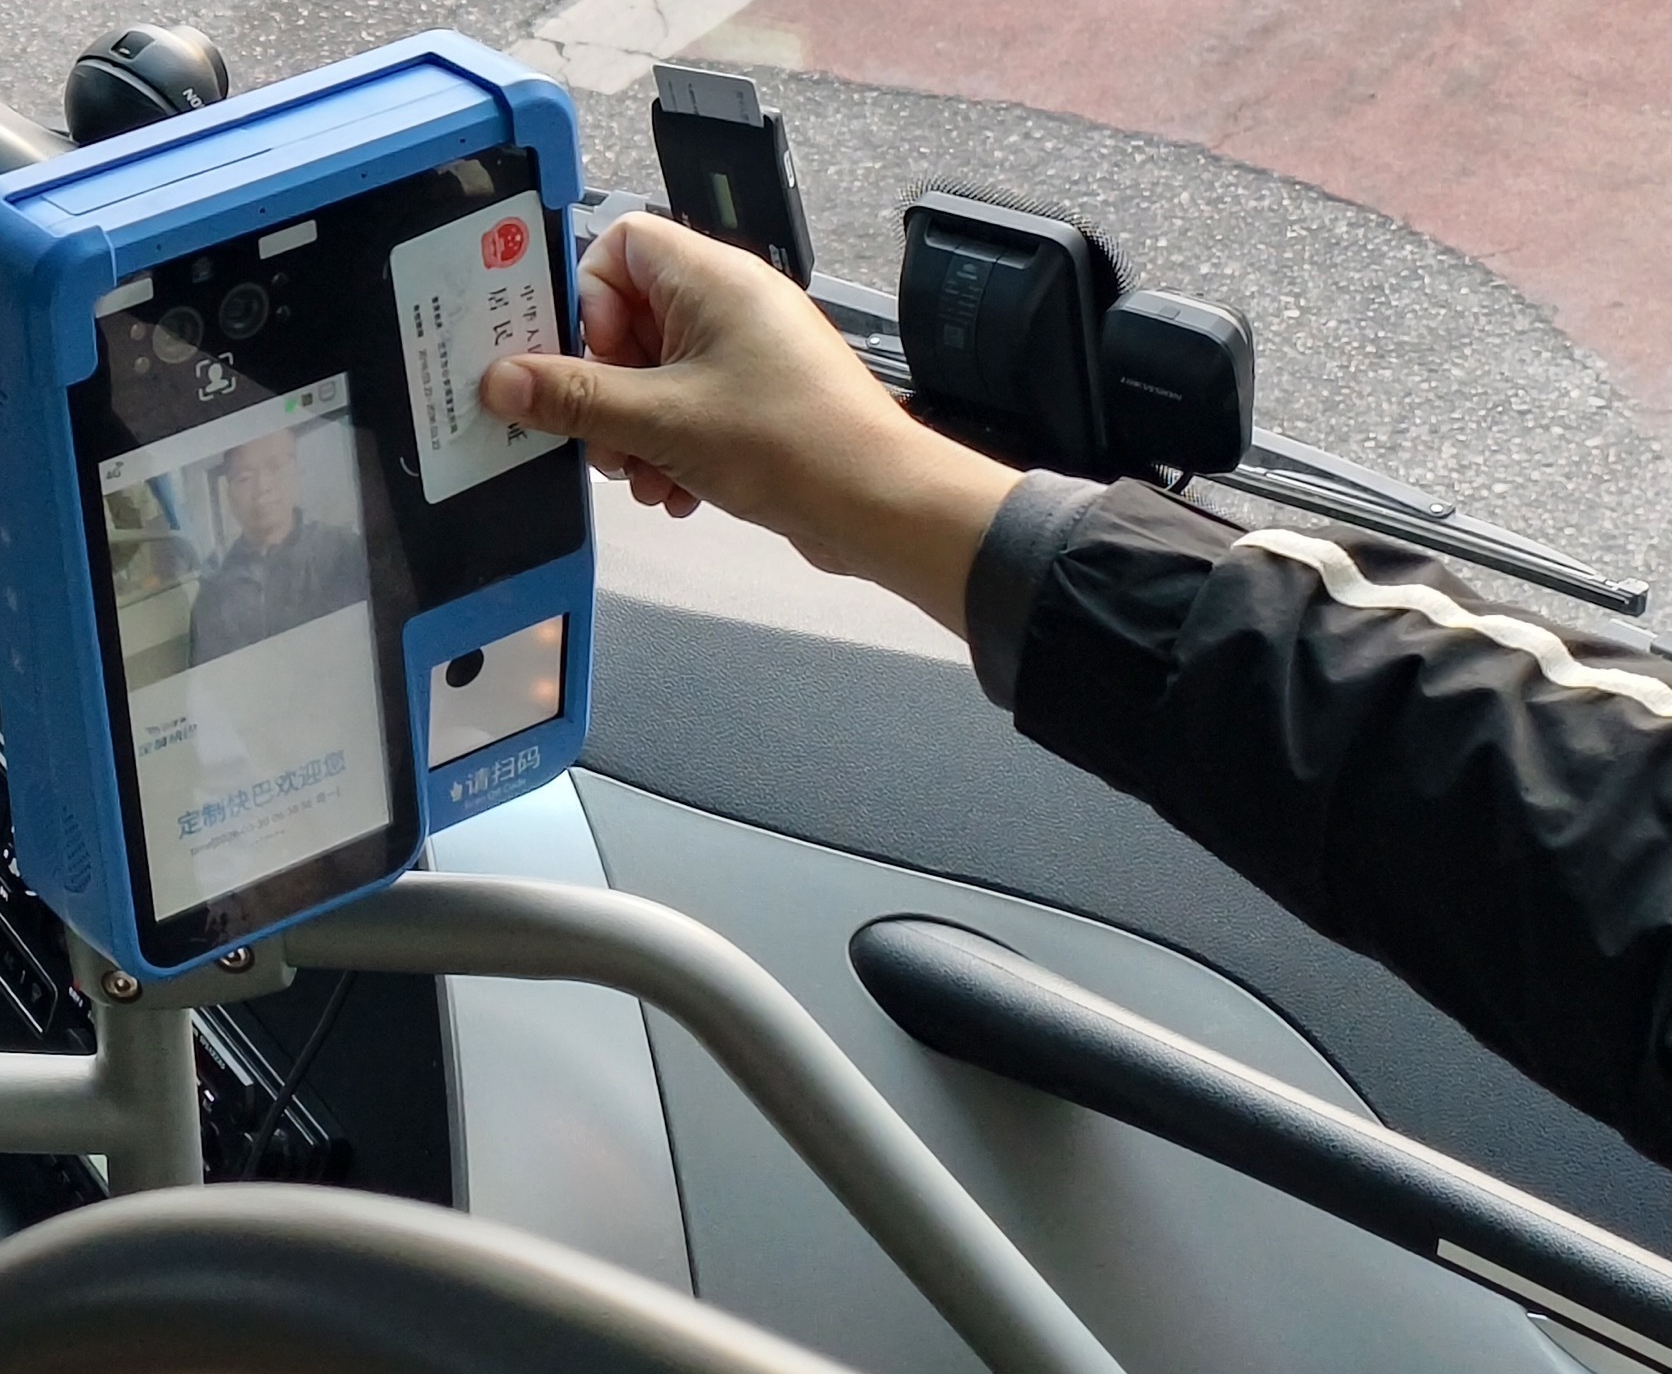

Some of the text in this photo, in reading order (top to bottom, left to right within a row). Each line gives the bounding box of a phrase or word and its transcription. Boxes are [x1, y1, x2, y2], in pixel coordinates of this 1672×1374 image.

[182, 87, 205, 109] NO
[176, 749, 347, 841] 定制快巴欢迎您
[464, 745, 541, 796] 请扫码
